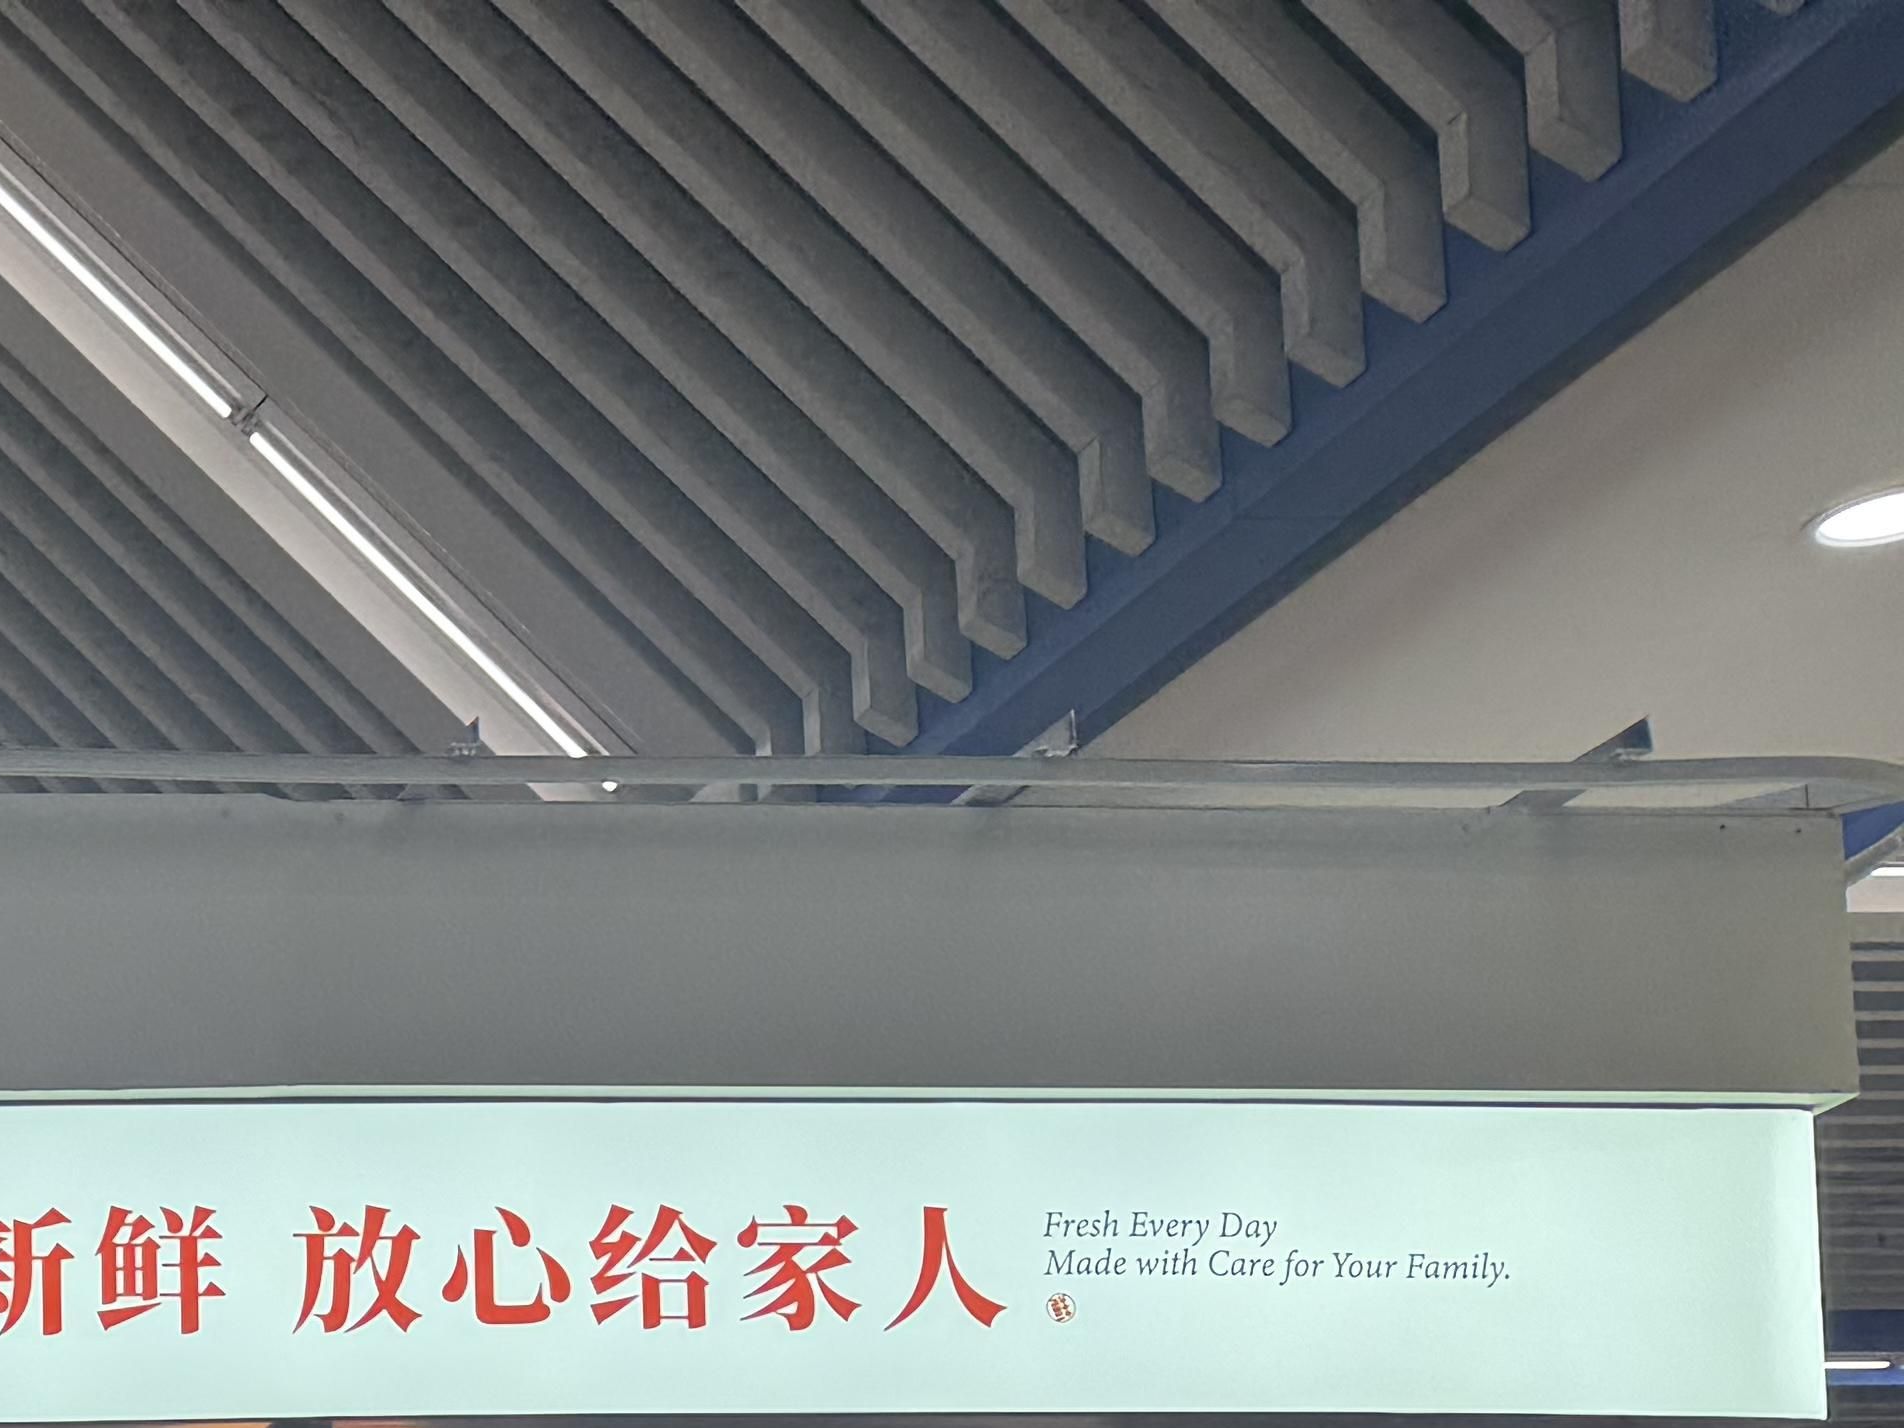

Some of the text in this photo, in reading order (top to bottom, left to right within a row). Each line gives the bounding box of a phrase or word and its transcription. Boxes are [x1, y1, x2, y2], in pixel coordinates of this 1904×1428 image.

[1042, 1210, 1278, 1247] Fresh Every Day
[292, 1205, 1007, 1338] 放心给家人
[1043, 1249, 1511, 1288] Made with Care for Your Family.
